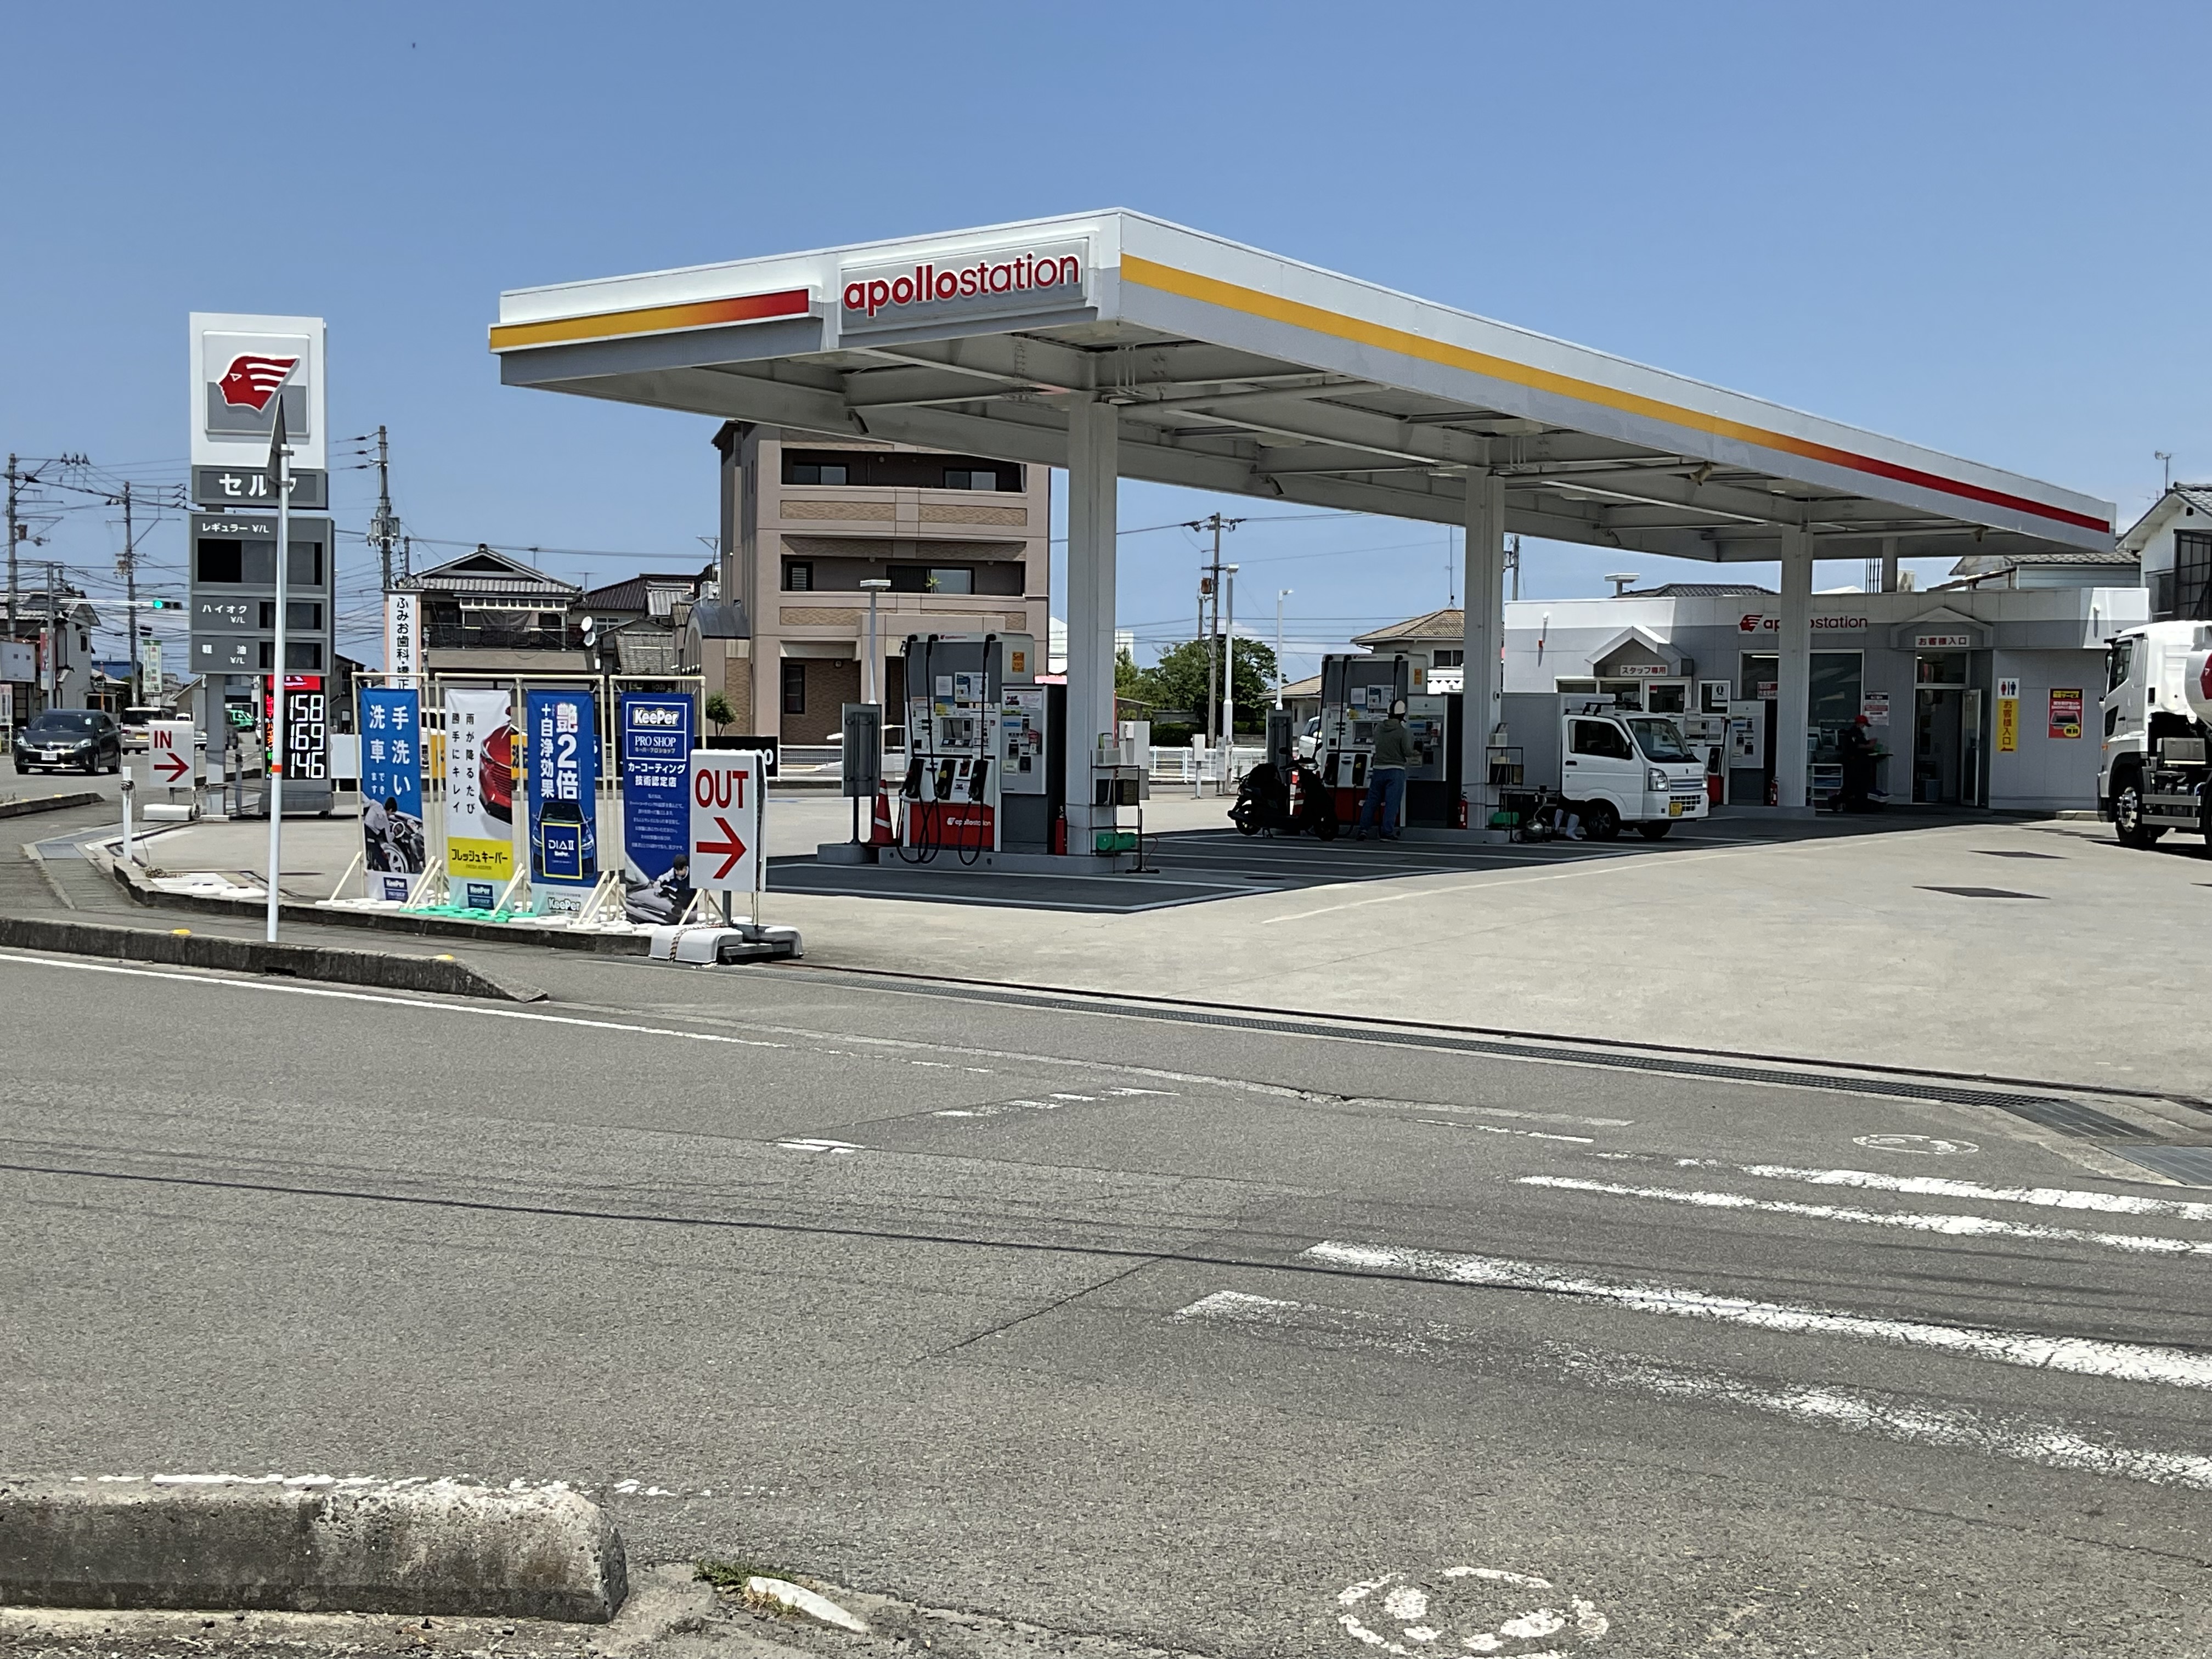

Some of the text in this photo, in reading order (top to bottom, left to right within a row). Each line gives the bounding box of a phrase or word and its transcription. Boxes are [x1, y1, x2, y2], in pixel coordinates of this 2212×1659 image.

[843, 253, 1080, 318] apollostation
[202, 523, 249, 533] レギュラー
[202, 605, 247, 614] ハイオク
[1763, 615, 1867, 632] apstation
[1918, 637, 1967, 646] お客様入口
[290, 695, 324, 721] 158
[634, 708, 679, 726] KeePer
[154, 731, 172, 748] IN
[290, 723, 325, 750] 169
[370, 704, 386, 764] 洗車
[635, 736, 676, 747] PRO SHOP
[392, 706, 410, 795] 手洗い
[290, 752, 325, 778] 146
[466, 713, 475, 814] 雨が降るたび
[628, 761, 686, 775] カーコーティング
[635, 775, 677, 787] 技術認定店
[695, 769, 749, 809] OUT
[451, 849, 508, 864] フレッシュキーパー
[548, 897, 581, 912] KeePer
